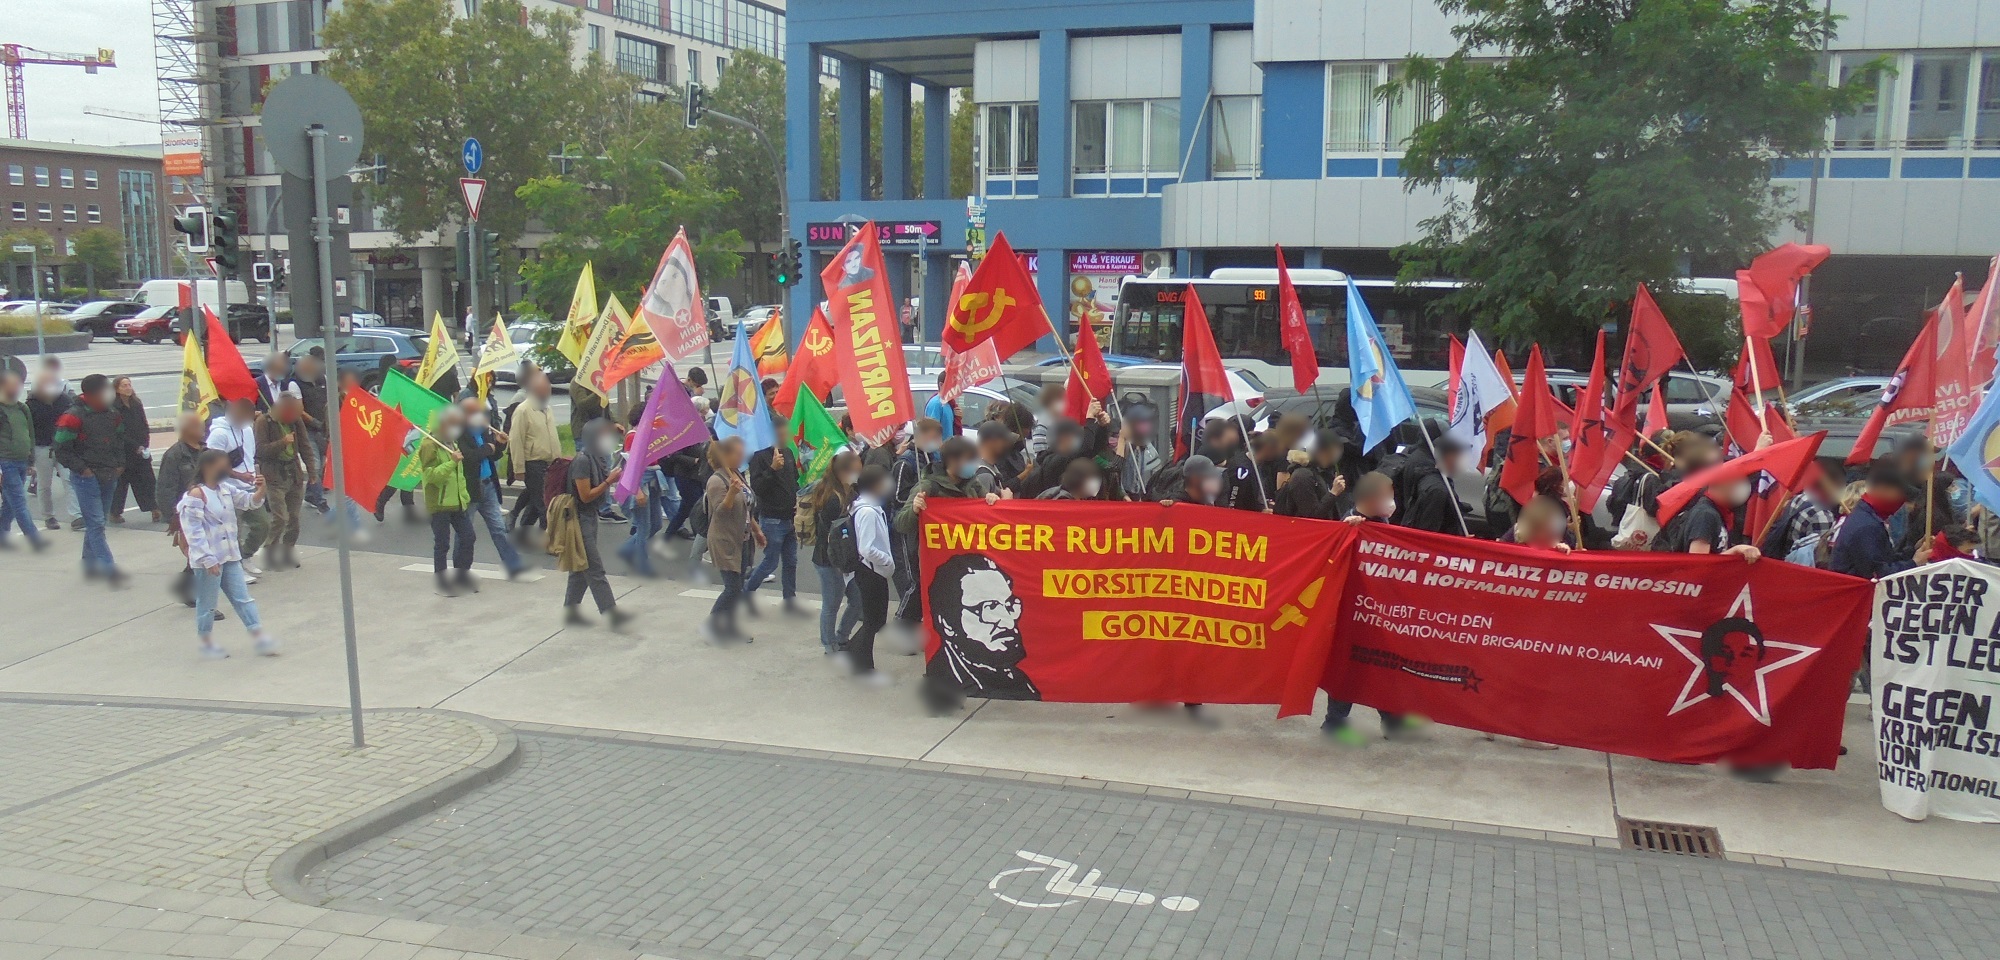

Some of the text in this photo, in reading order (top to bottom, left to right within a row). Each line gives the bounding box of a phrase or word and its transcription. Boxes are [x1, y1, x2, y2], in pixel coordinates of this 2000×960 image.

[809, 226, 843, 240] SUN
[904, 225, 922, 234] 50m
[1077, 254, 1136, 264] AN & VERKAUF
[1254, 290, 1266, 300] 931
[924, 523, 1269, 563] EWIGER RUHM DEM
[1358, 539, 1703, 598] NEHMT DEN PLATZ DER GENOSSIN
[1358, 561, 1588, 604] IVANA HOFFMANN EIN!
[1051, 573, 1262, 606] VORSITZENDEN
[1885, 573, 1989, 607] UNSER
[1101, 613, 1263, 647] GONZALO!
[1418, 608, 1458, 626] EUCH
[1460, 614, 1493, 630] DEN
[1882, 600, 1979, 637] GEGEN
[1352, 610, 1663, 671] INTERNATIONALEN BRIGADEN IN ROJAVA AN!
[1883, 630, 1940, 666] IST
[1879, 740, 1921, 771] VON
[1878, 761, 2000, 800] INTERTIONAL
